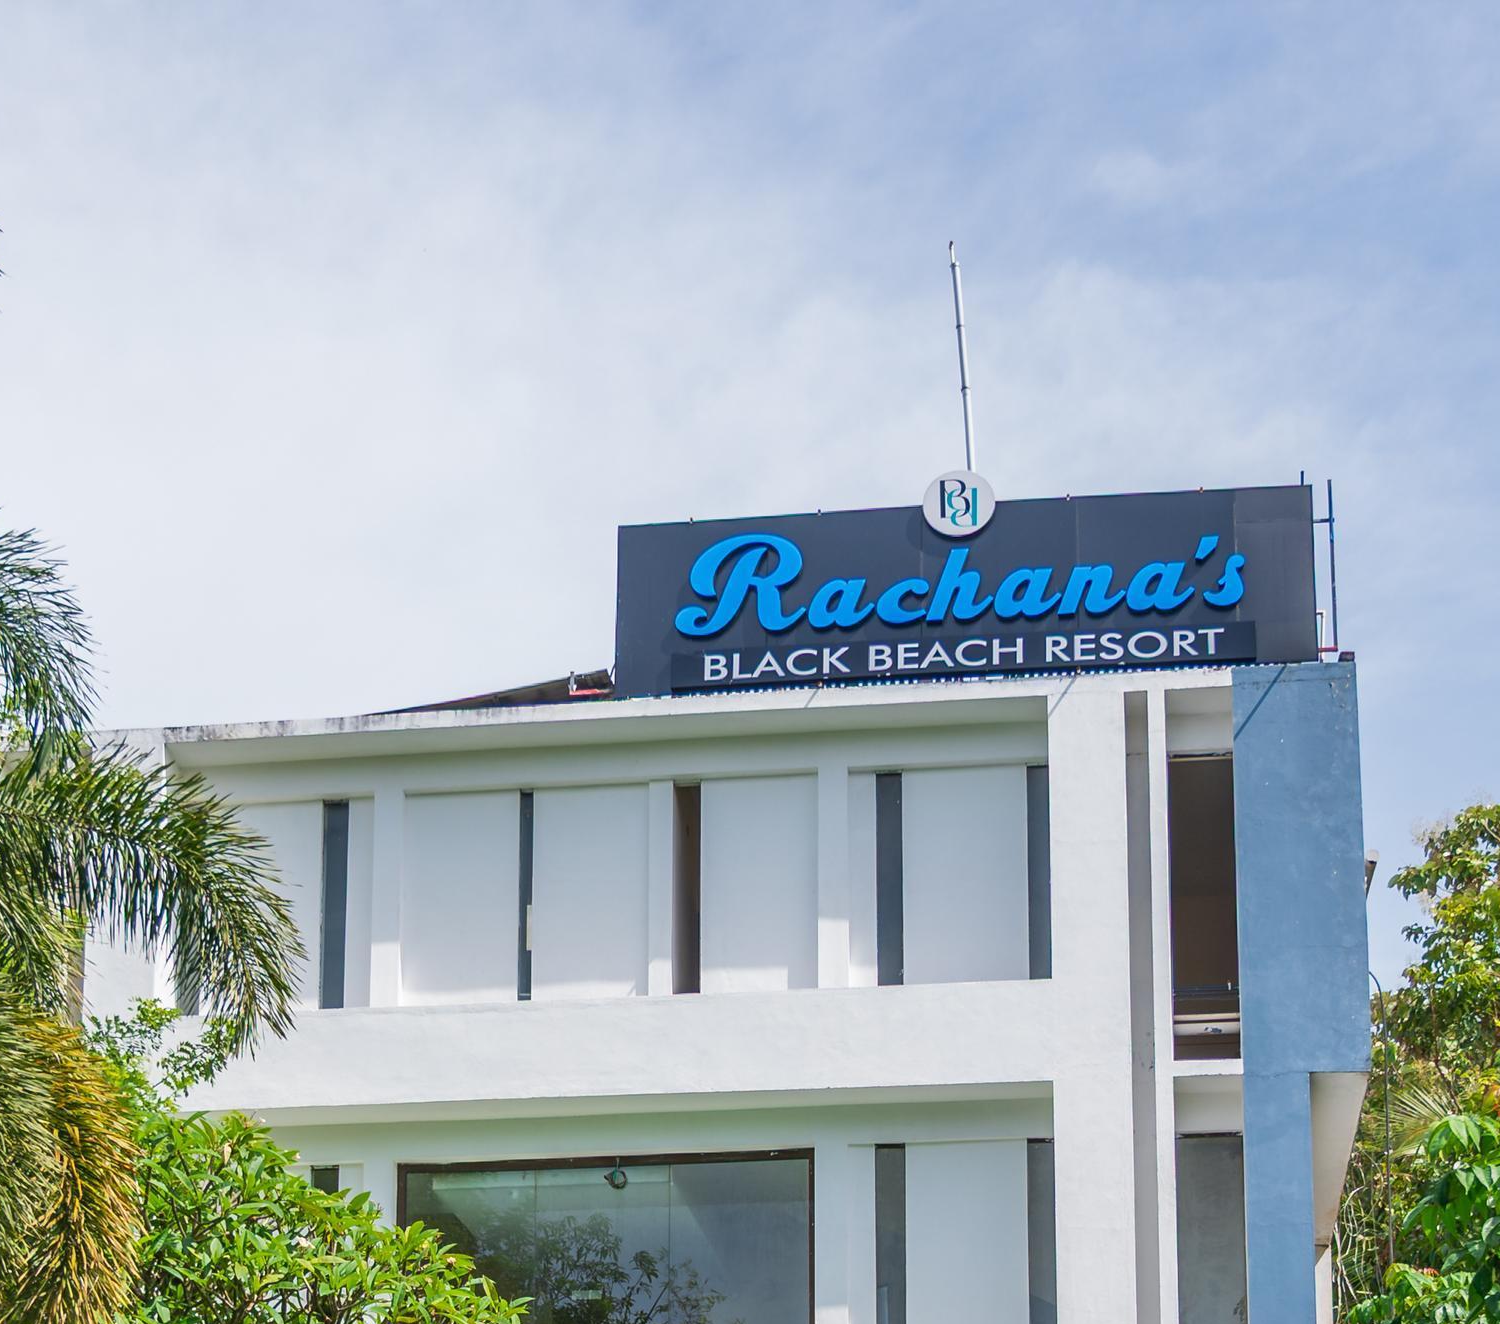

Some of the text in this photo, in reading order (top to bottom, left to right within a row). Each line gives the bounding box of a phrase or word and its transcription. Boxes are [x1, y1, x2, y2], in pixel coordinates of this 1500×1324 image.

[674, 533, 1246, 637] Rachana's
[703, 627, 1225, 682] BLACK BEACH RESORT
